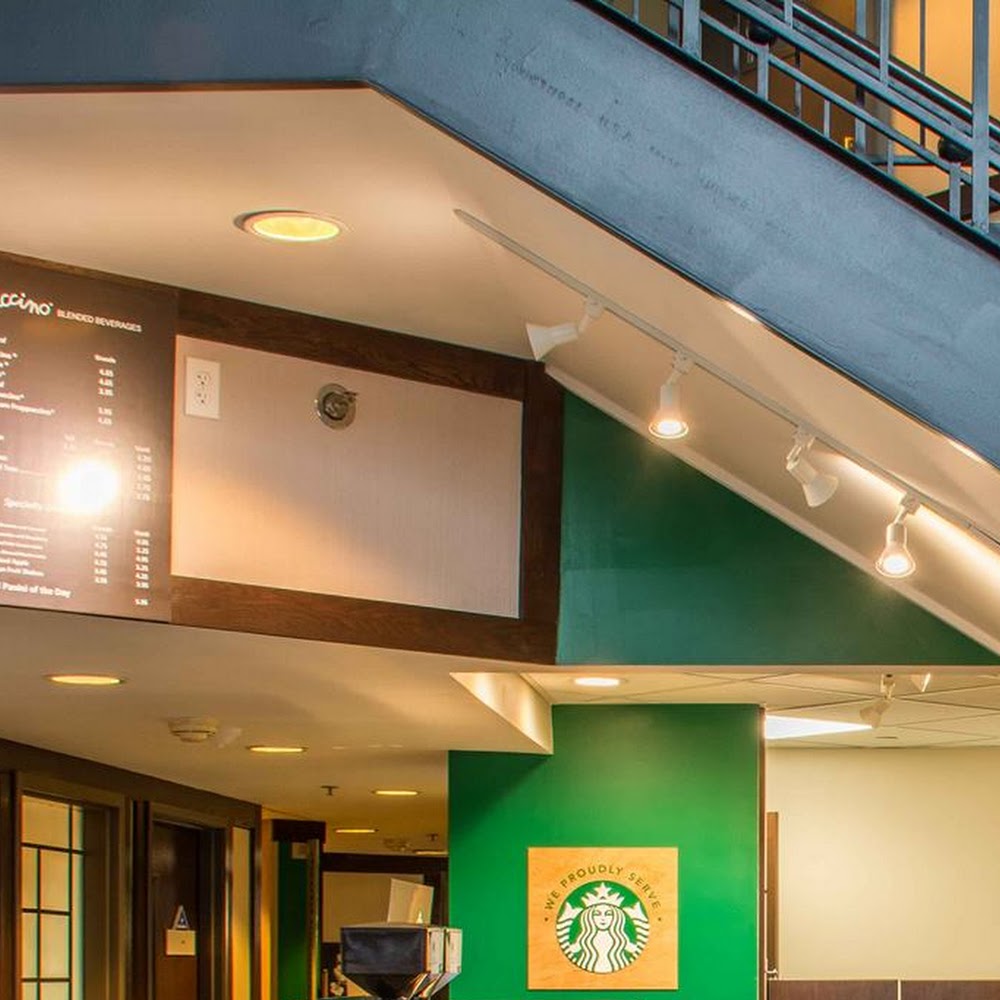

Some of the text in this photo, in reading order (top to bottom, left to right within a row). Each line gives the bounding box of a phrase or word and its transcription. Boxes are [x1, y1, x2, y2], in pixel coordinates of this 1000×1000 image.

[57, 309, 94, 323] BLENDED
[95, 316, 142, 332] BEVERAGES
[544, 864, 662, 911] WE PROUDLY SERVE
